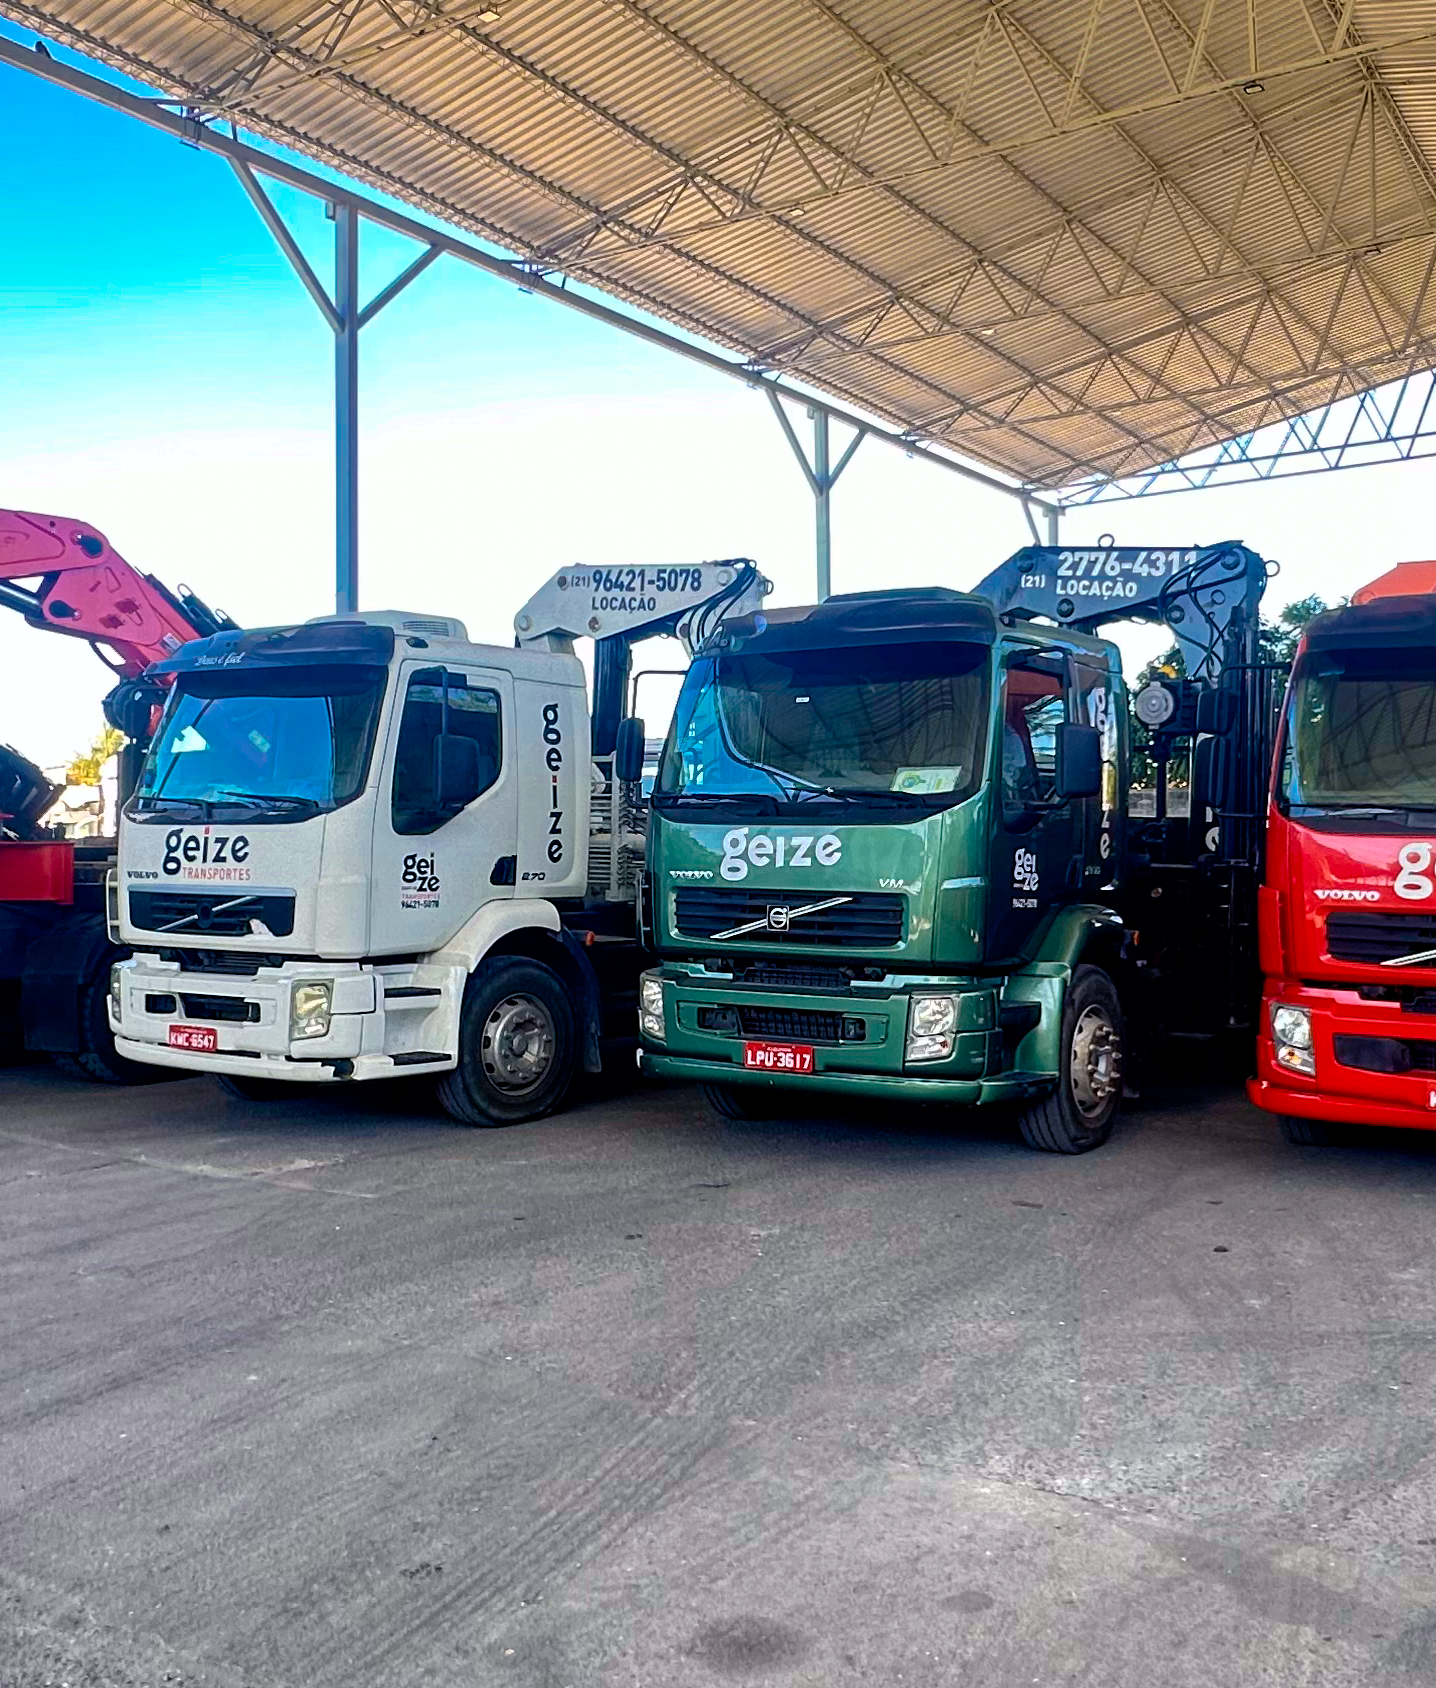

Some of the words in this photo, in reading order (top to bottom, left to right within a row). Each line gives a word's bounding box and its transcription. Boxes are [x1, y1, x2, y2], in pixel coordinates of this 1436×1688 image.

[571, 576, 590, 588] (21)
[593, 568, 702, 592] 96421-5078
[1021, 575, 1045, 588] (21)
[1056, 577, 1137, 600] LOCAÇÃO
[592, 593, 656, 614] LOCAÇÃO
[543, 703, 563, 864] geize
[163, 825, 250, 876] geize
[720, 827, 842, 881] geize
[127, 871, 158, 879] VOLVO
[182, 866, 251, 881] TRANSPORTES
[879, 878, 904, 888] VM
[1313, 889, 1380, 901] VOLVO
